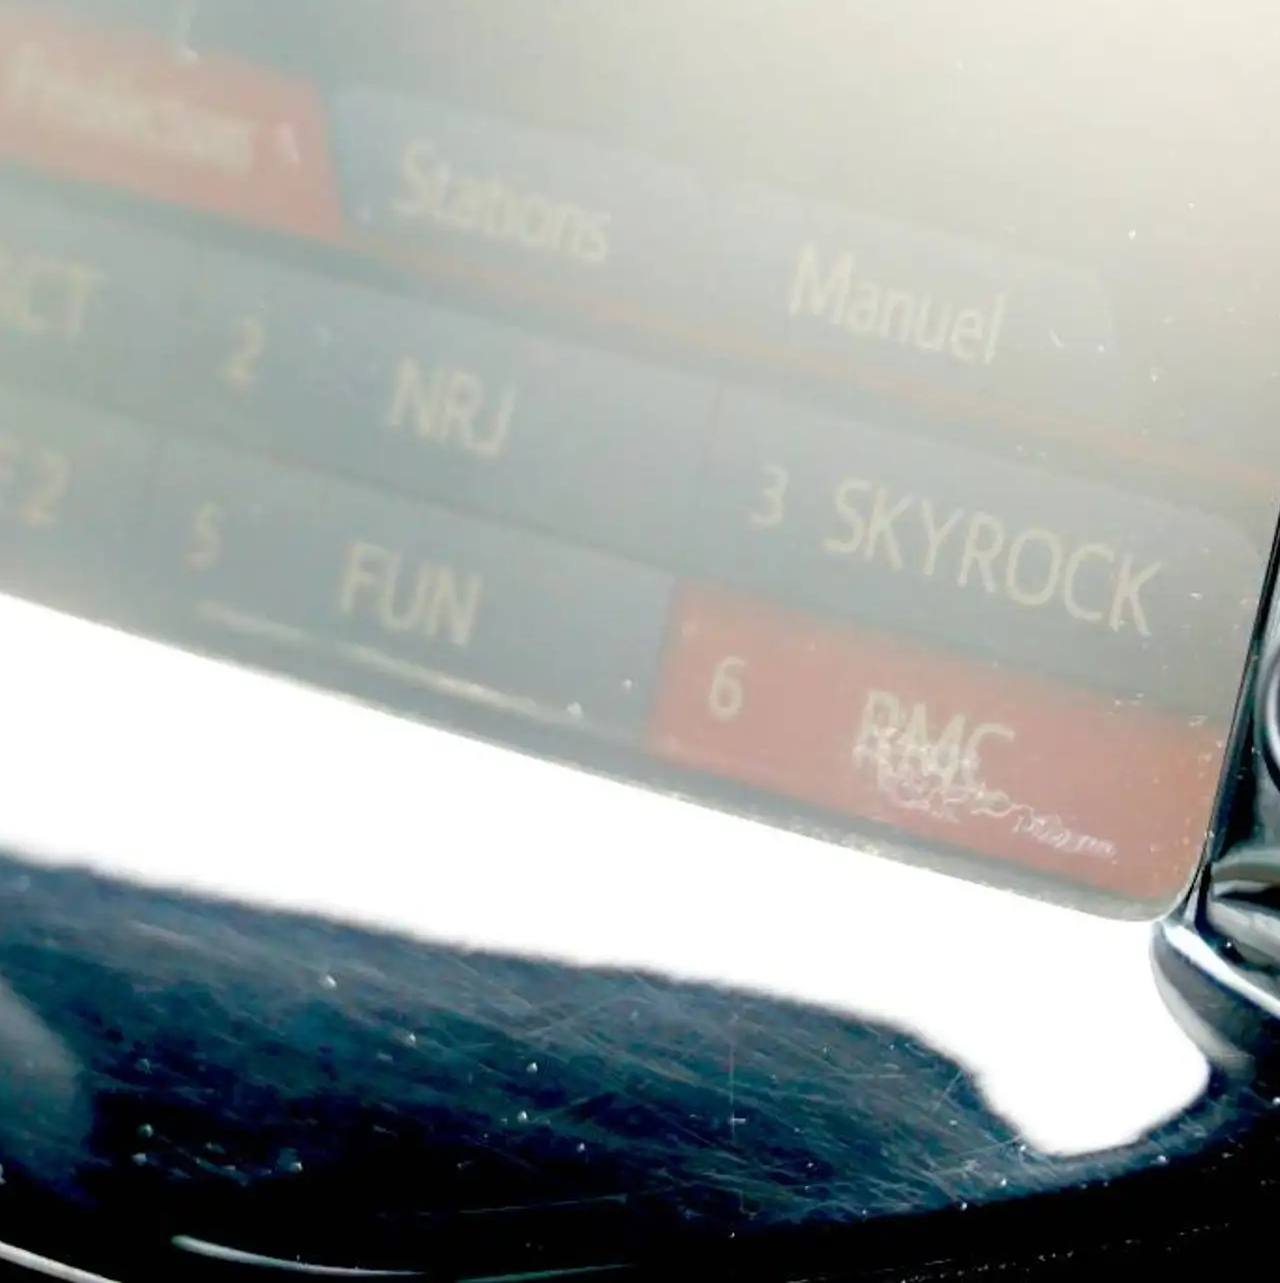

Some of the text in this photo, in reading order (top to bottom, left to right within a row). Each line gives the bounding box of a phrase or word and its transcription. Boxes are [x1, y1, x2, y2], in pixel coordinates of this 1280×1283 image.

[392, 139, 611, 264] Stations
[788, 244, 1007, 365] Manuel
[219, 316, 514, 458] 2 NRJ
[188, 503, 484, 648] 5 FUN
[749, 465, 1163, 637] 3 SKYROCK
[707, 656, 1017, 798] 6 RMC
